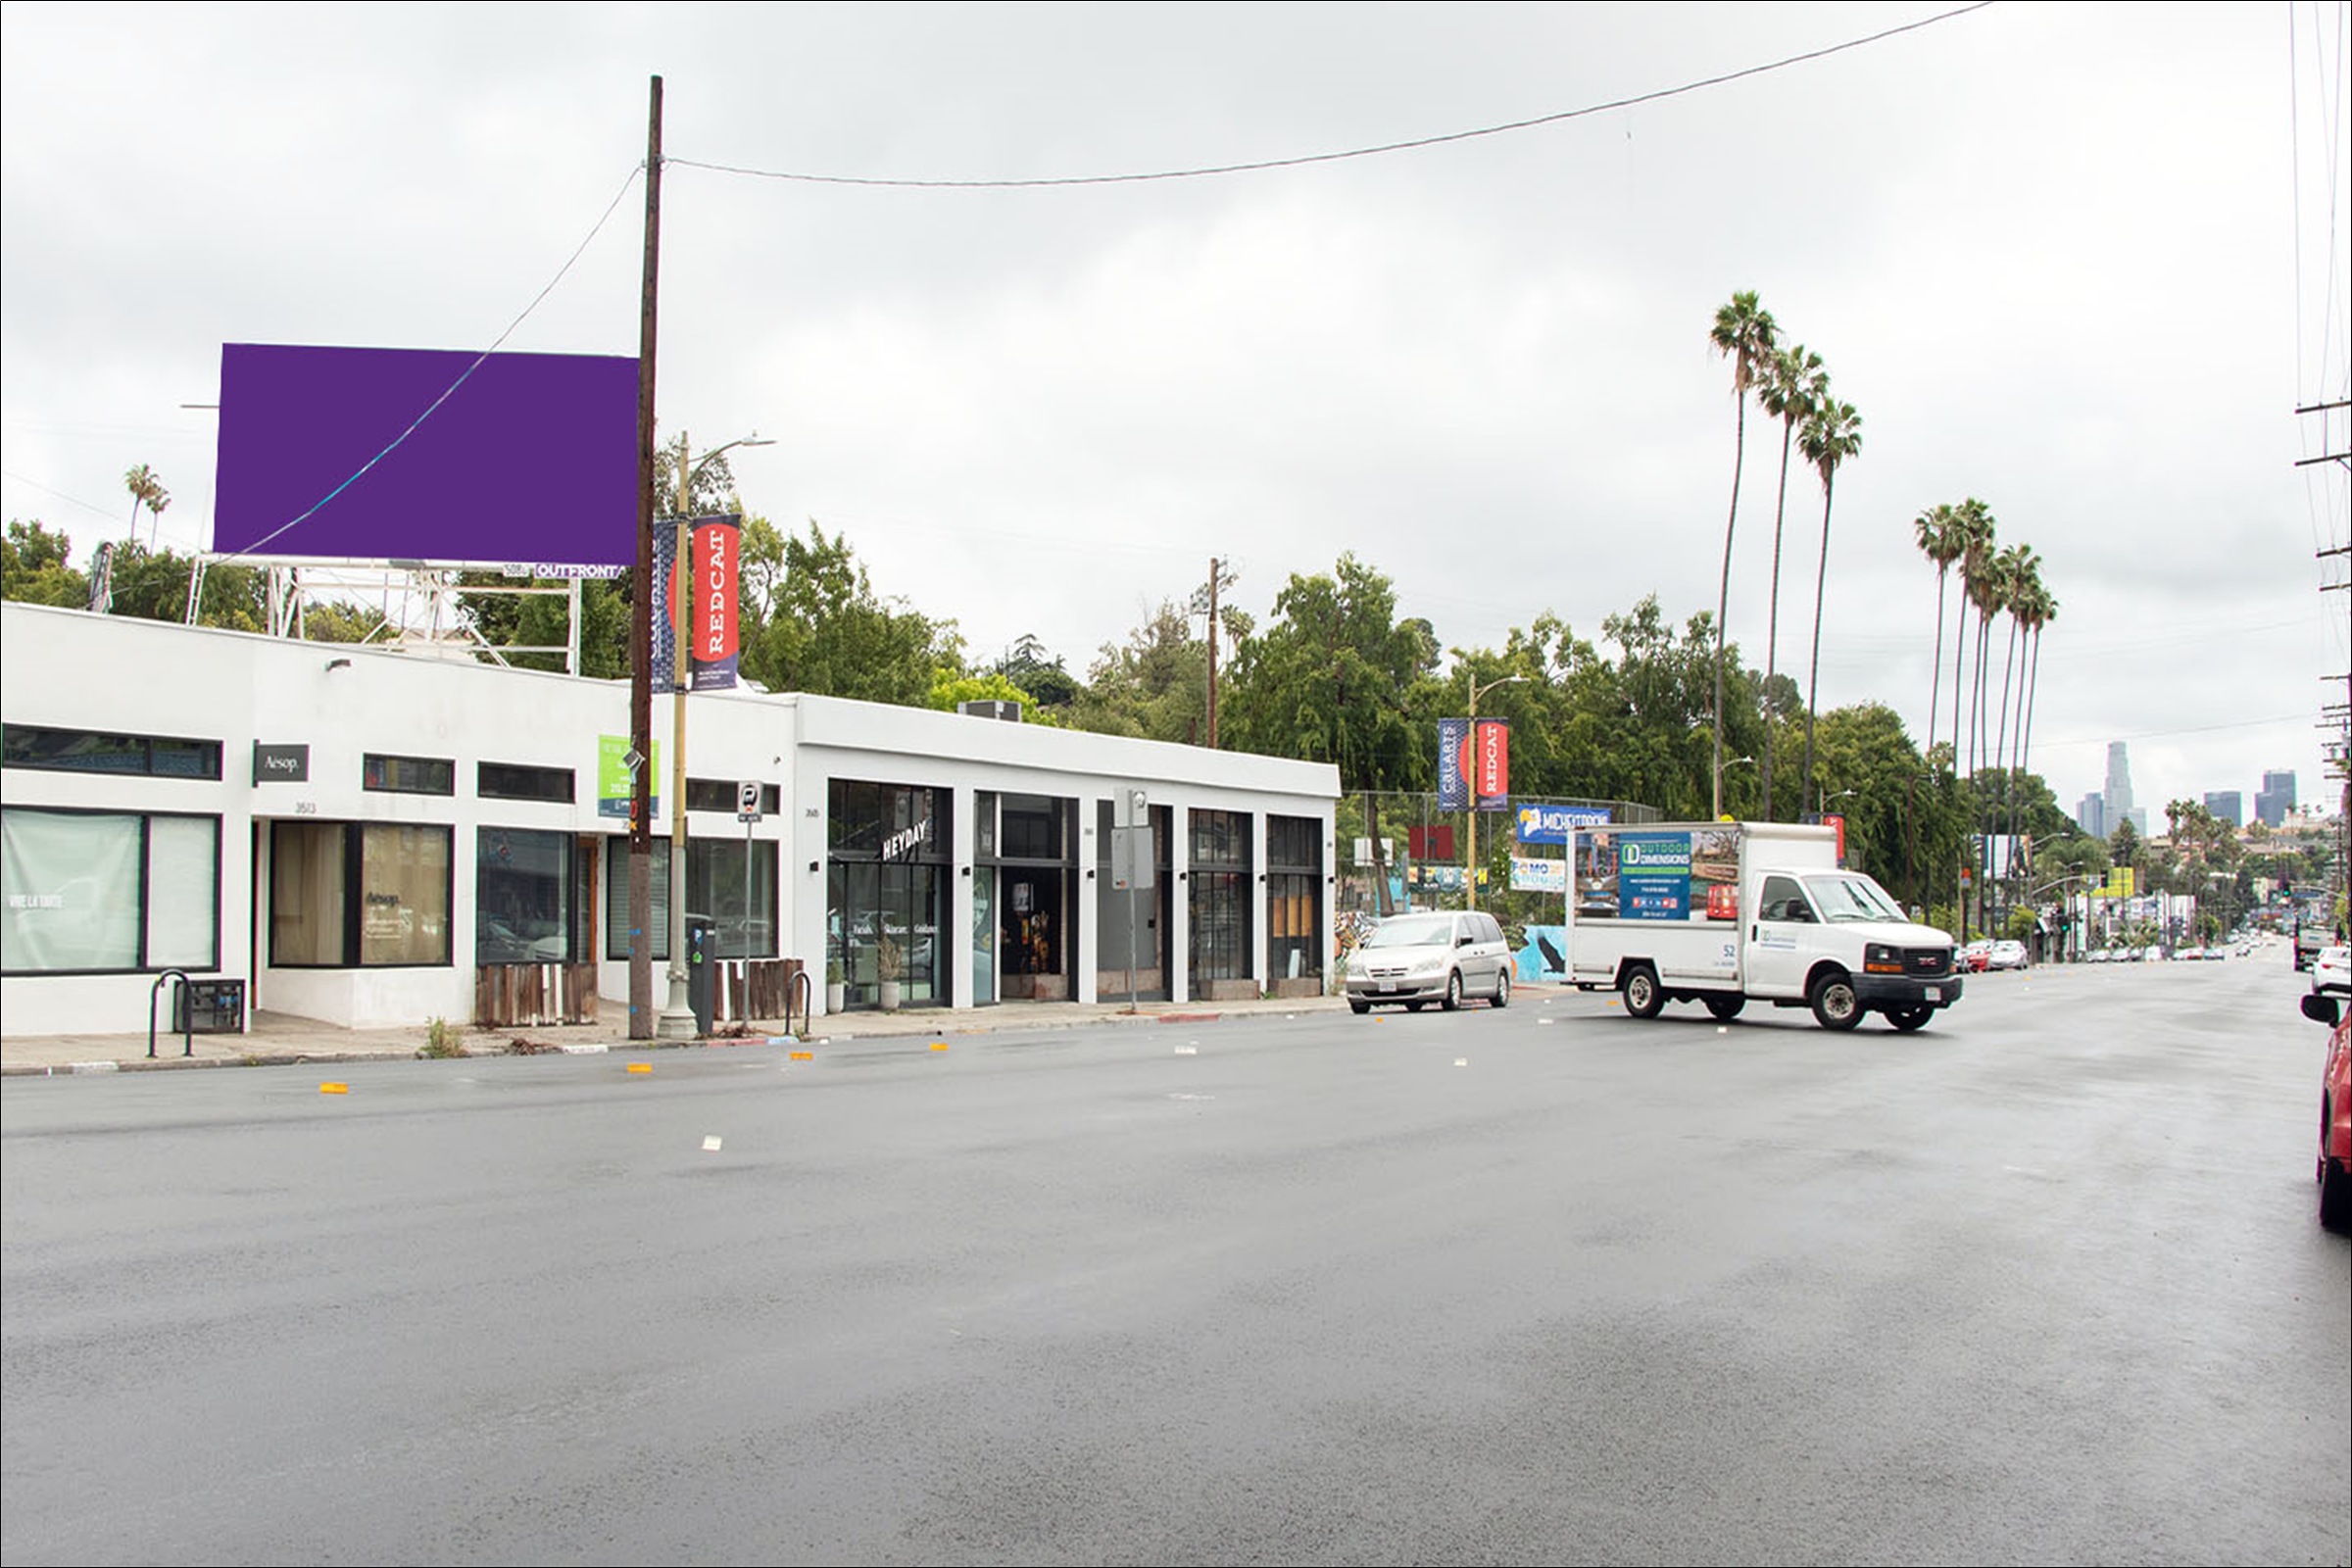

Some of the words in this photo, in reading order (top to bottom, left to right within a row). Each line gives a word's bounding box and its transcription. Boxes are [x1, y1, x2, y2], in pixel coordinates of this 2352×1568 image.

[536, 564, 621, 578] OUTFRONT
[709, 529, 725, 655] REDCAT
[1486, 725, 1497, 793] REDCAT
[883, 819, 927, 861] HEYDAY
[1640, 844, 1690, 854] OUTDOOR
